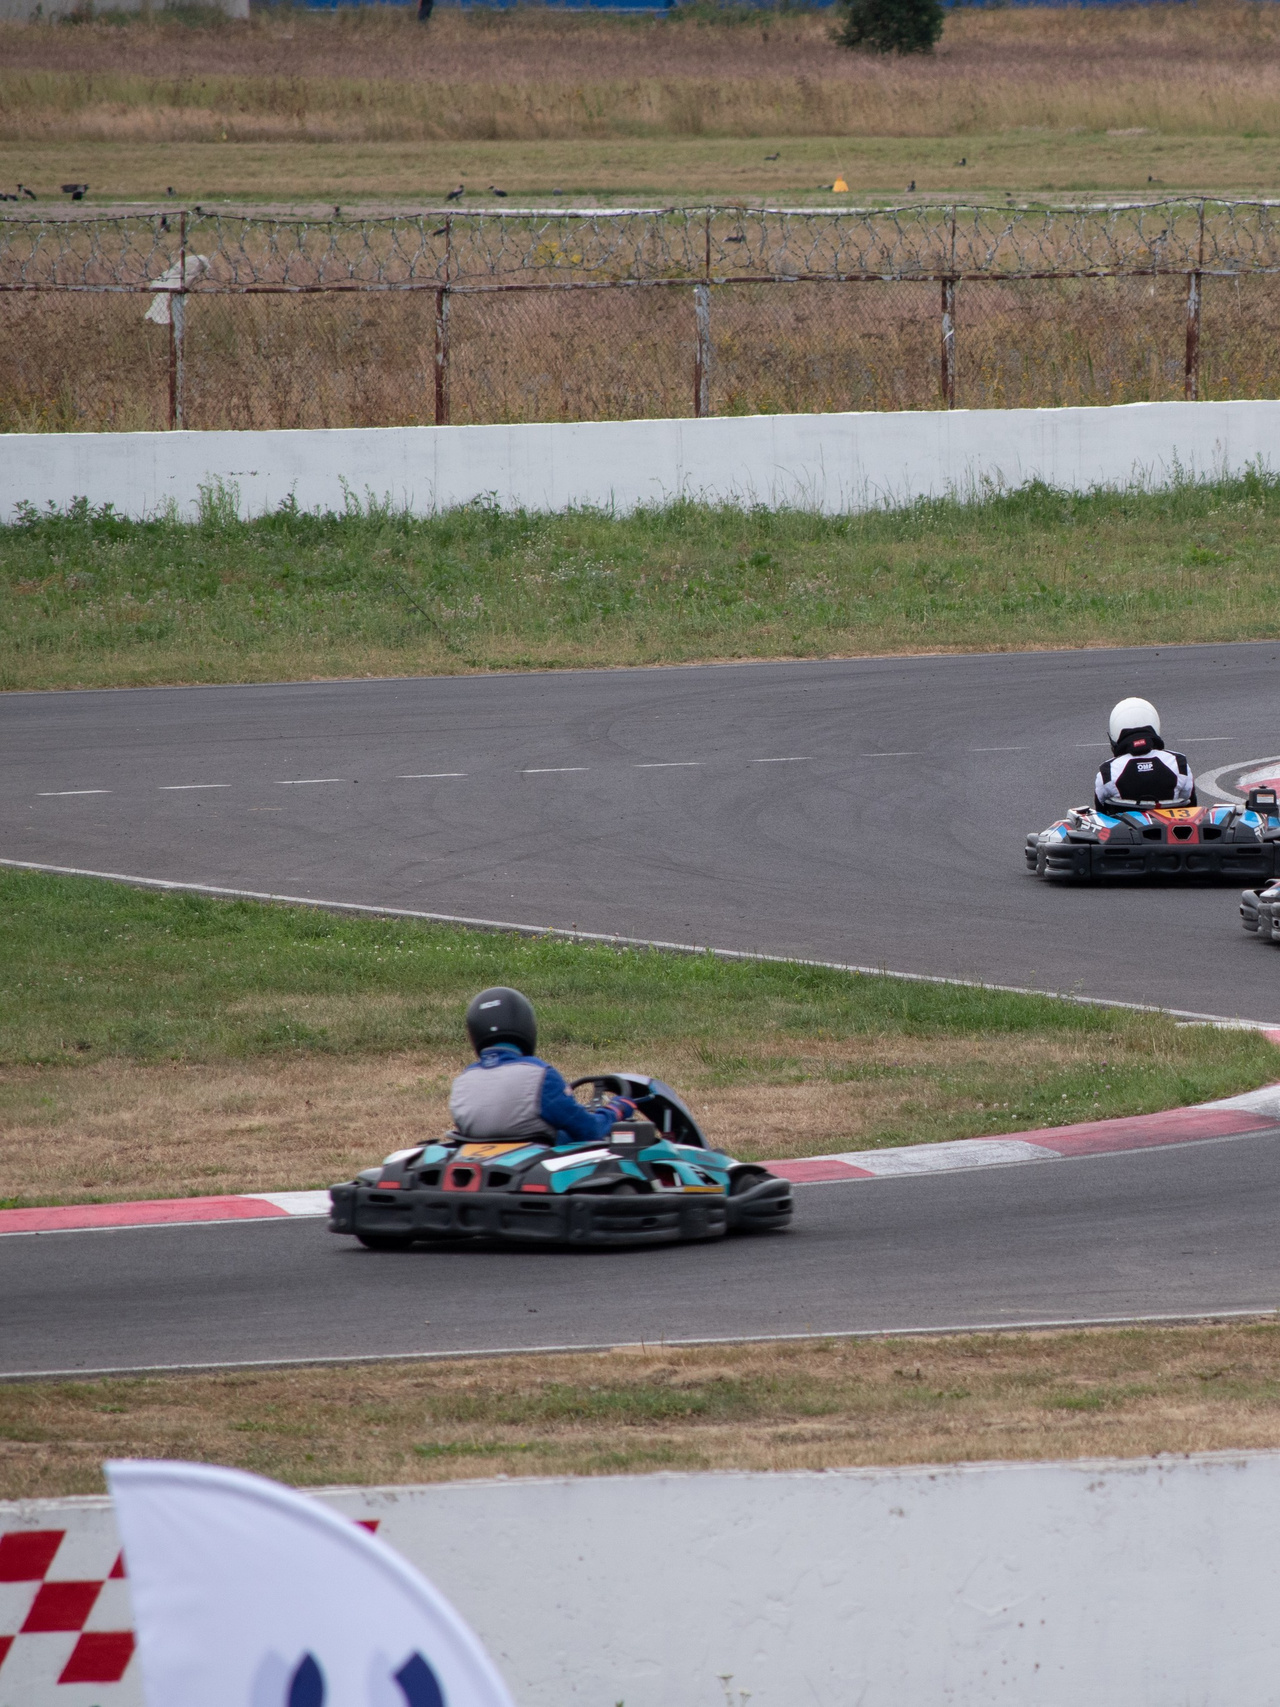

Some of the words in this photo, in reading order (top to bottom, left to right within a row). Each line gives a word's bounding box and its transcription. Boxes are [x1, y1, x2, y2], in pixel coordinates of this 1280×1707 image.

[1137, 763, 1153, 771] OMP
[1166, 809, 1191, 818] 13
[471, 1144, 497, 1156] 2
